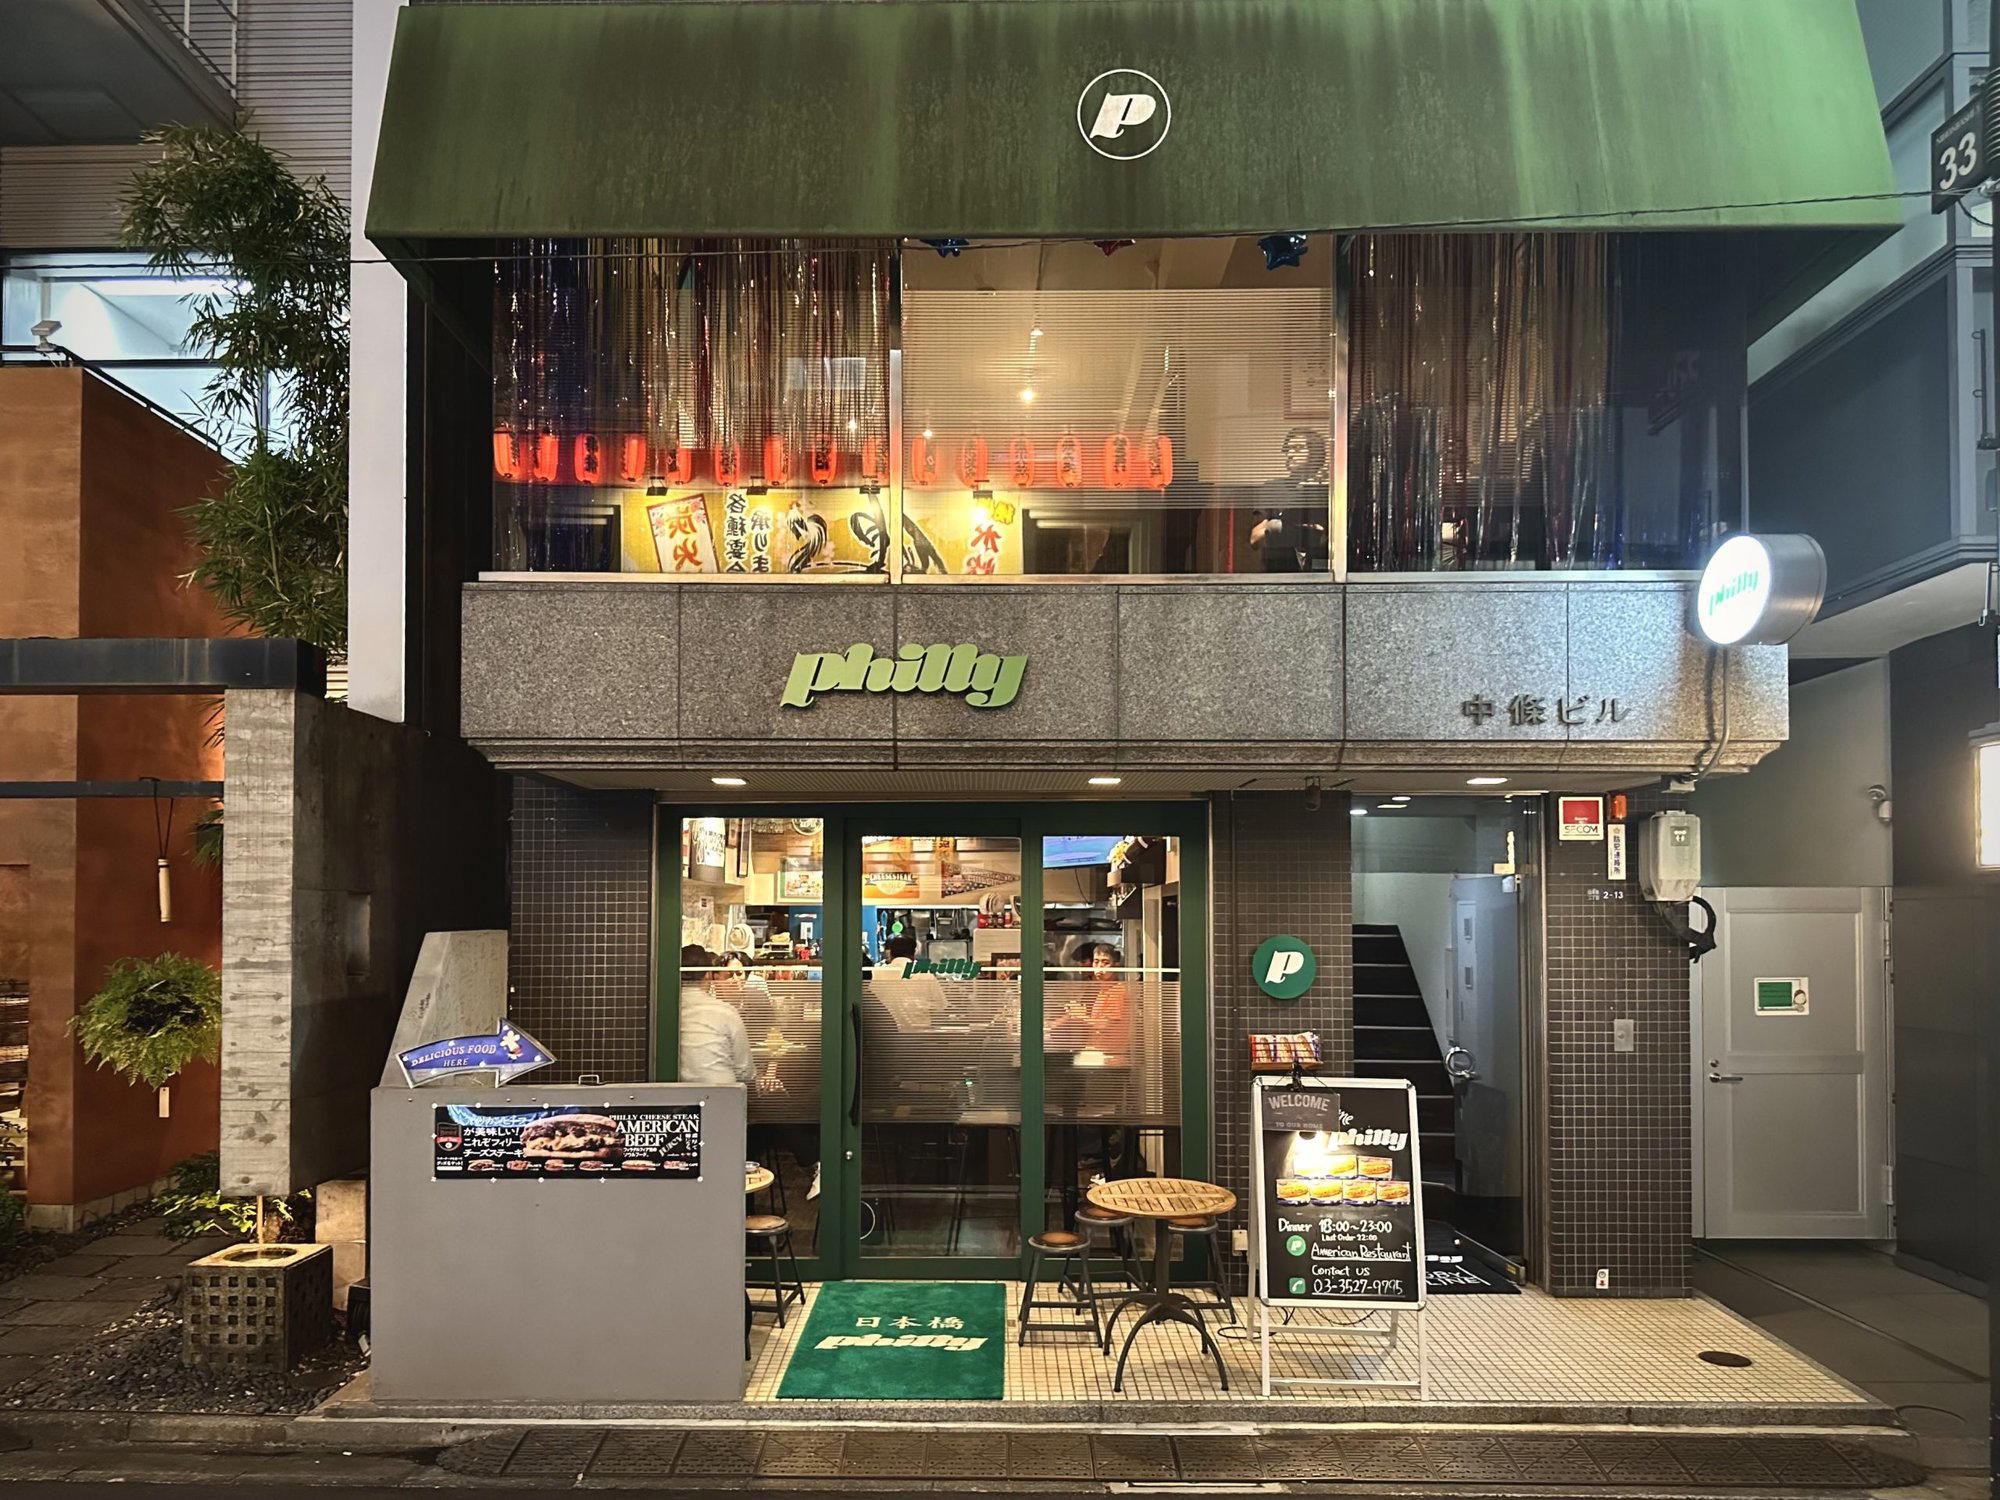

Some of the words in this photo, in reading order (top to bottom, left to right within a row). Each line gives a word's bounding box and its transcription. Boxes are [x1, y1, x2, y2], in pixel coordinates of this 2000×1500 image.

[1939, 131, 1977, 190] 33
[1708, 569, 1759, 616] philly
[780, 643, 1028, 708] philly
[1564, 825, 1599, 834] SECOM
[1603, 890, 1624, 900] 2-13
[901, 957, 981, 980] philly
[410, 1045, 465, 1067] DELICIOUS
[467, 1044, 497, 1055] FOOD
[443, 1057, 469, 1067] HERE
[1268, 1093, 1331, 1112] WELCOME
[615, 1120, 700, 1134] AMERICAN
[463, 1137, 523, 1147] これぞフィリー
[624, 1133, 668, 1147] BEEF
[1327, 1128, 1409, 1152] philly
[1278, 1217, 1312, 1232] Dinner
[1321, 1233, 1336, 1241] Last
[1337, 1233, 1356, 1241] Order
[1311, 1243, 1358, 1258] American
[1360, 1241, 1412, 1260] Restaurant
[1311, 1264, 1350, 1277] Contact
[1355, 1267, 1371, 1276] us
[855, 1316, 965, 1330] 日本橋
[813, 1334, 989, 1351] philly
